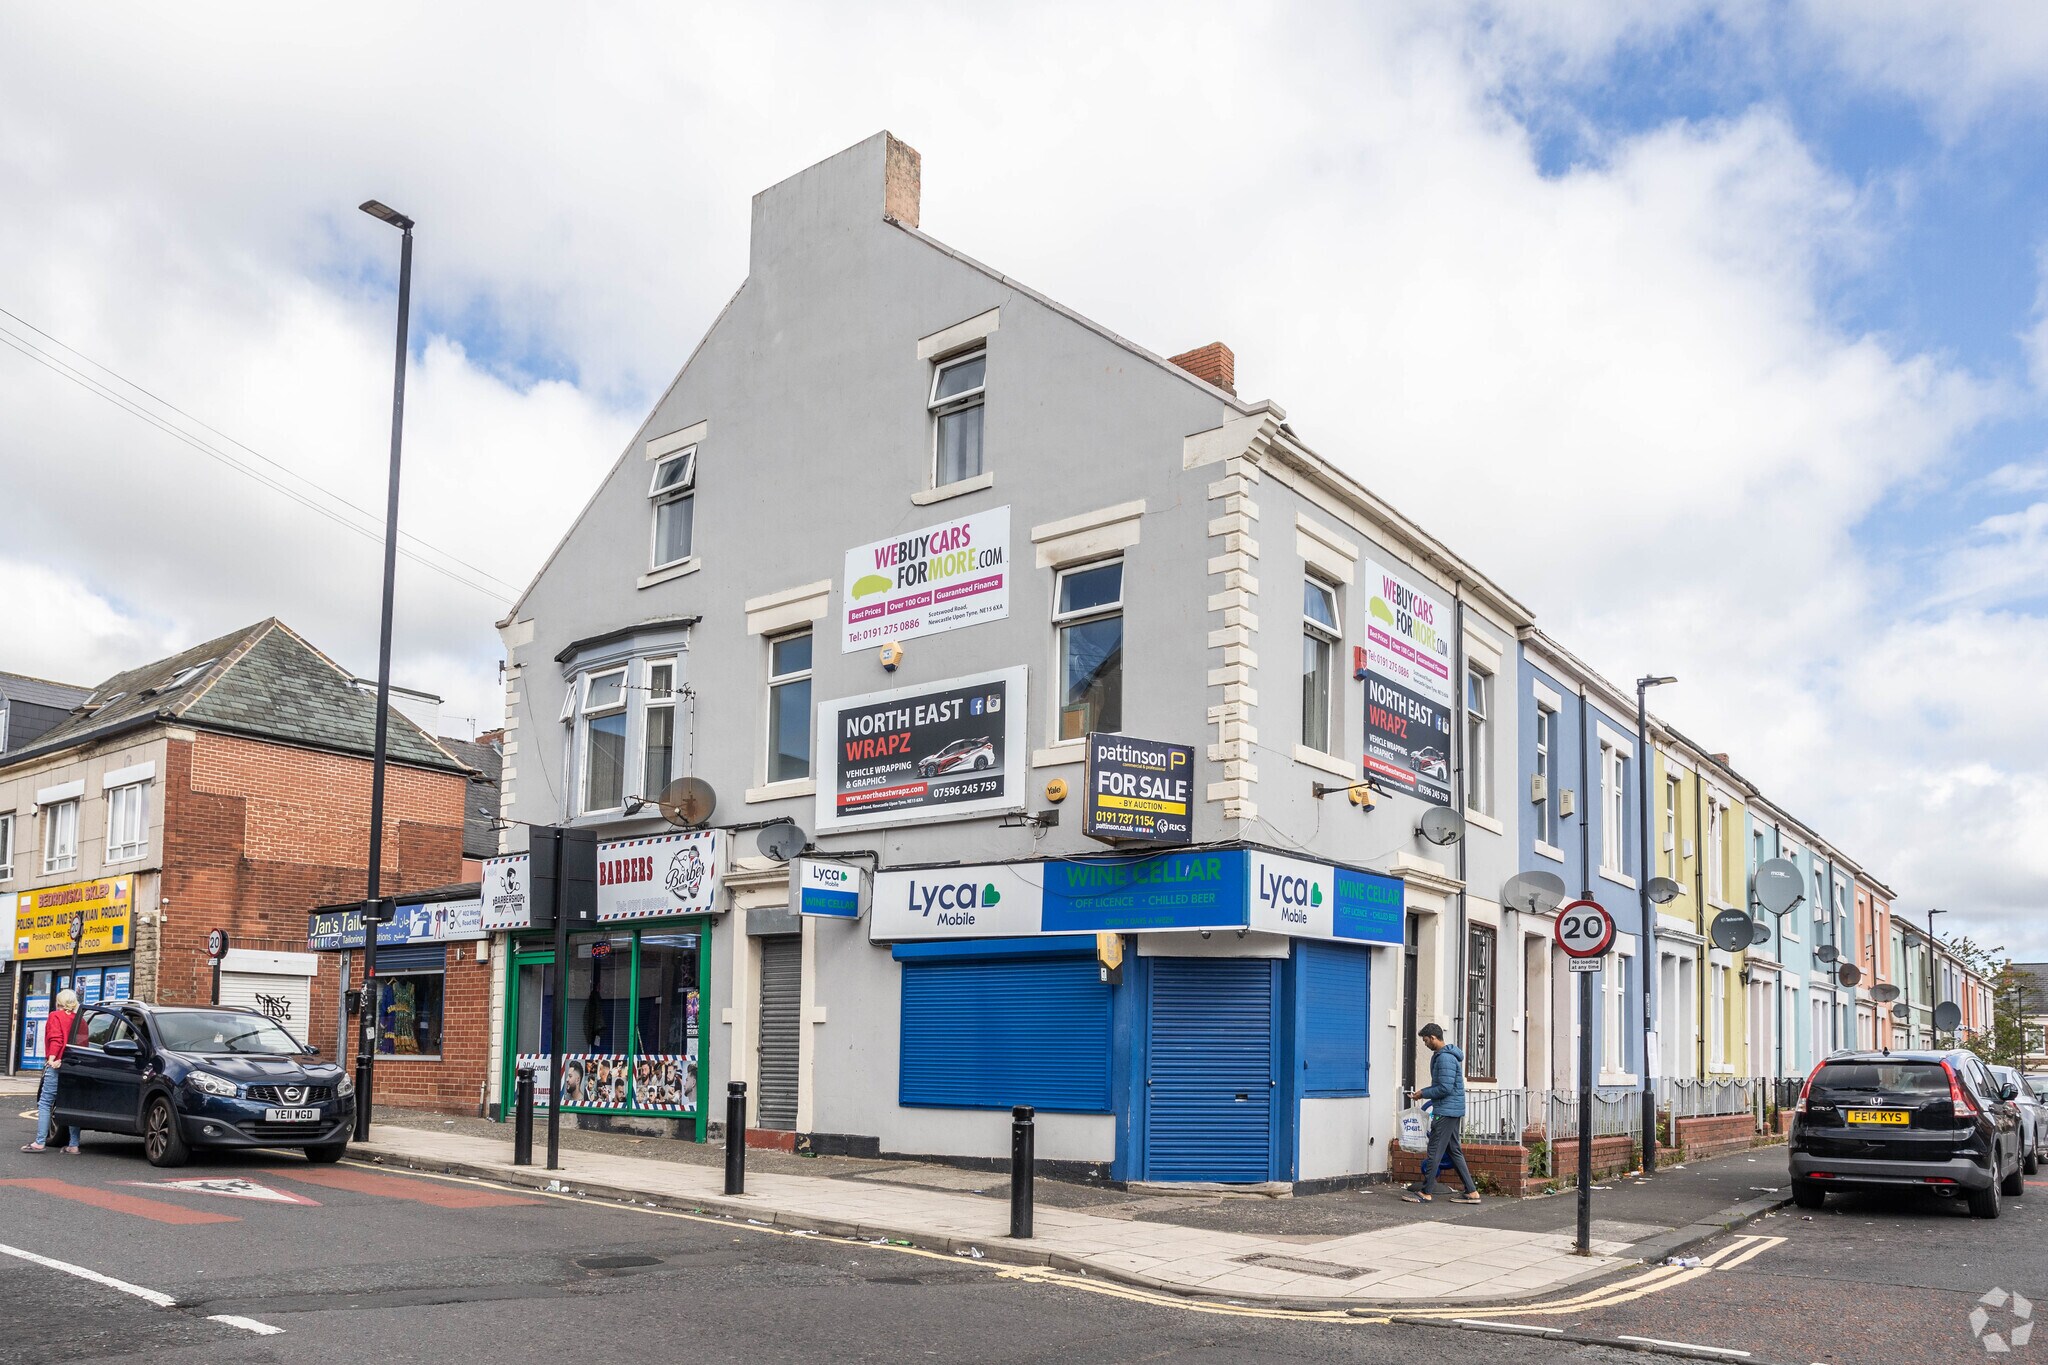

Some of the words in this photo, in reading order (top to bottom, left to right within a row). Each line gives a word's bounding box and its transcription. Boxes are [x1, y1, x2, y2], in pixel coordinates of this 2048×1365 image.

[875, 524, 971, 570] WEBUYCARS
[898, 546, 1003, 589] FORMORE.COM
[936, 583, 973, 599] Guaranteed
[974, 579, 999, 591] Finance
[890, 602, 904, 611] Over
[905, 599, 916, 607] 100
[916, 595, 930, 605] Cars
[1382, 575, 1434, 625] WEBUYCARS
[851, 611, 864, 620] Best
[865, 607, 882, 617] Prices
[928, 615, 952, 625] Newcastle
[952, 612, 965, 621] Upon
[849, 631, 861, 643] Tel:
[863, 626, 881, 640] 0191
[883, 623, 899, 635] 275
[900, 618, 920, 631] 0886
[1396, 609, 1448, 659] FORMORE.COM
[1369, 679, 1407, 716] NORTH
[1408, 698, 1433, 727] EAST
[846, 708, 910, 738] NORTH
[914, 698, 964, 727] EAST
[1369, 704, 1408, 739] WRAPZ
[846, 732, 911, 762] WRAPZ
[1369, 733, 1387, 748] VEHICLE
[1386, 738, 1408, 756] WRAPPING
[1097, 743, 1167, 767] pattinson
[1373, 746, 1394, 761] GRAPHICS
[845, 765, 874, 779] VEHICLE
[874, 760, 912, 775] WRAPPING
[845, 781, 851, 789] &
[852, 775, 887, 788] GRAPHICS
[933, 785, 960, 799] 07596
[962, 783, 978, 795] 245
[980, 781, 997, 793] 759
[1047, 785, 1061, 795] Yale
[1097, 770, 1137, 797] FOR
[1139, 775, 1187, 802] SALE
[845, 785, 924, 802] www.northeastwrapz.com
[1123, 799, 1133, 807] BY
[1133, 801, 1163, 811] AUCTION
[1095, 822, 1134, 832] pattinson.co.uk
[1096, 810, 1116, 822] 0191
[1118, 812, 1134, 825] 737
[1135, 814, 1155, 827] 1154
[1169, 823, 1187, 832] RICS
[599, 855, 653, 886] BARBERS
[665, 862, 706, 890] Barber
[813, 865, 839, 881] Lyca
[1065, 864, 1127, 888] WINE
[1133, 858, 1222, 885] CELLAR
[84, 884, 109, 901] SKLEP
[1260, 864, 1308, 909] Lyca
[1338, 879, 1365, 900] WINE
[1366, 884, 1400, 906] CELLAR
[493, 893, 524, 905] BARBERSHOP
[805, 897, 826, 907] WINE
[828, 898, 856, 909] CELLAR
[908, 880, 976, 917] Lyca
[1075, 898, 1093, 909] OFF
[1095, 896, 1134, 907] LICENCE
[1148, 894, 1189, 906] CHILLED
[1191, 893, 1216, 904] BEER
[37, 915, 54, 928] CZECH
[56, 912, 67, 925] AND
[100, 904, 127, 919] PRODUCT
[310, 915, 339, 936] Jan's
[341, 912, 366, 932] Tailo
[937, 912, 975, 926] Mobile
[1281, 907, 1307, 924] Mobile
[71, 922, 79, 934] 20
[1563, 915, 1603, 939] 20
[84, 938, 100, 948] FOOD
[209, 936, 219, 949] 20
[342, 934, 364, 944] Tailoring
[591, 944, 611, 955] OPEN
[275, 1109, 293, 1120] YE11
[294, 1109, 313, 1120] WGD
[1854, 1111, 1878, 1121] FE14
[1880, 1112, 1902, 1122] KYS
